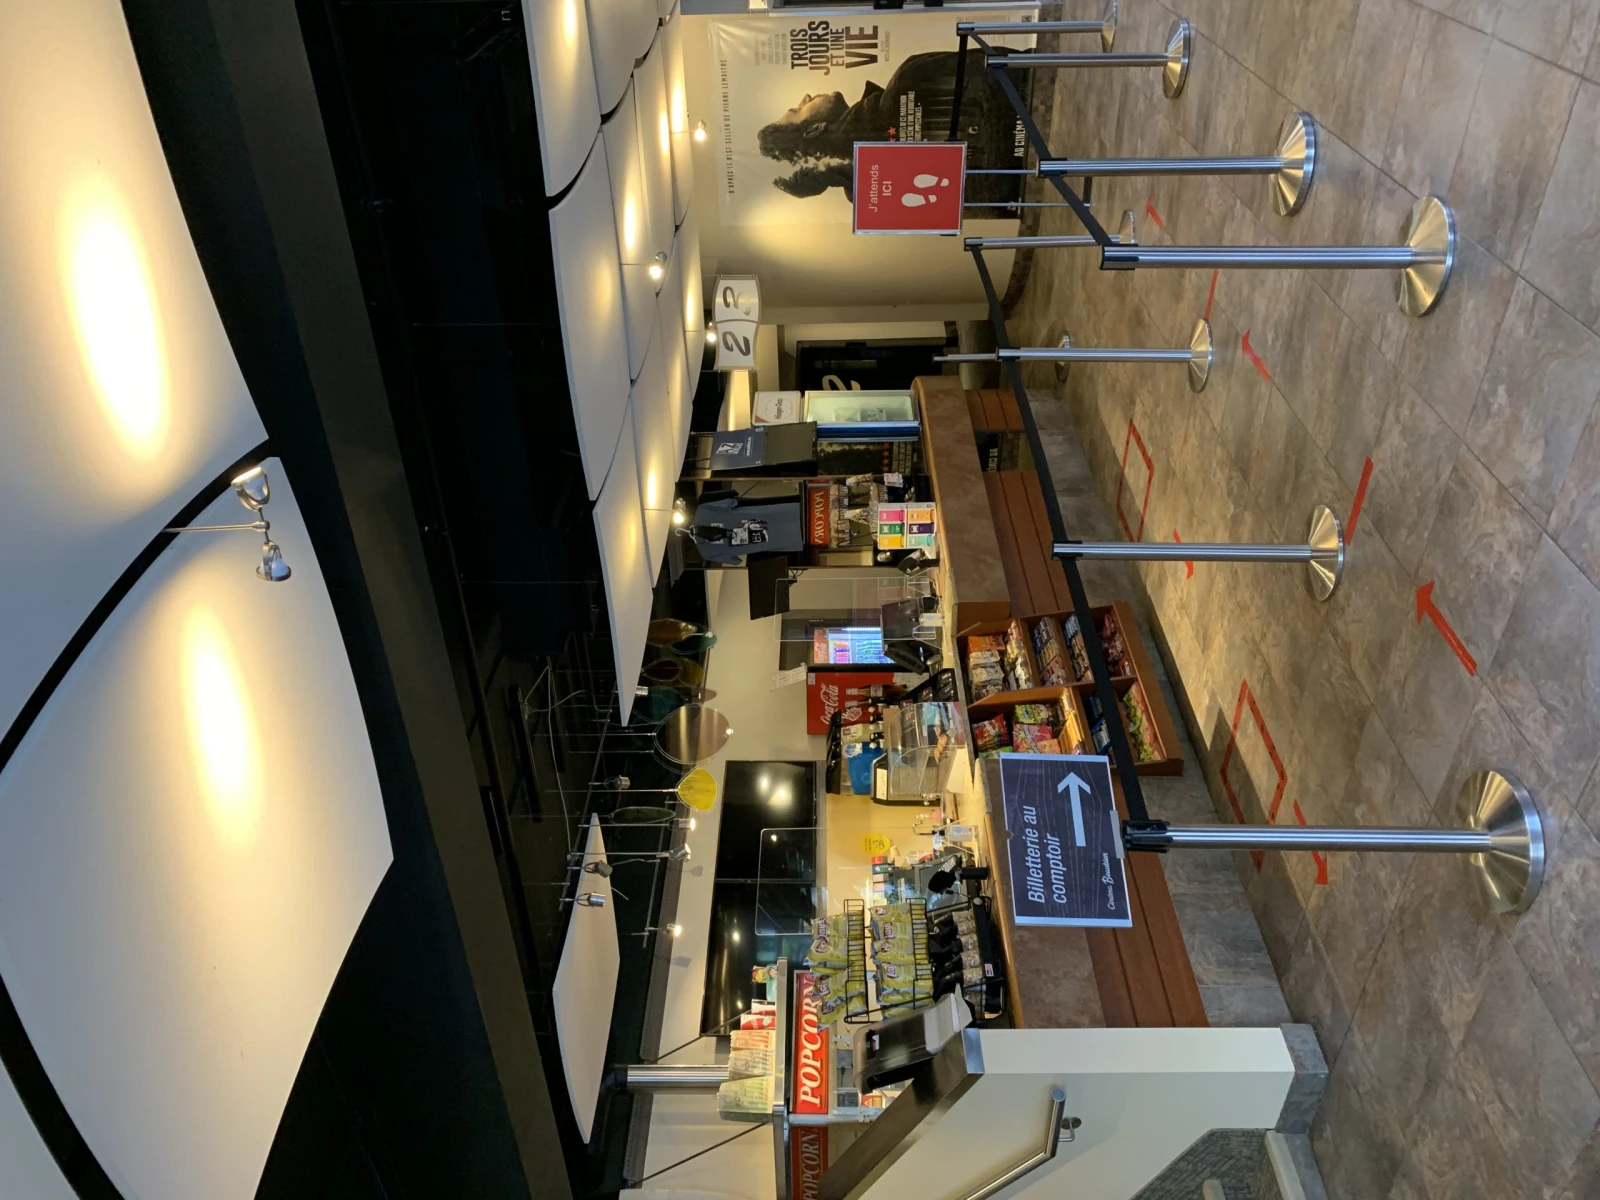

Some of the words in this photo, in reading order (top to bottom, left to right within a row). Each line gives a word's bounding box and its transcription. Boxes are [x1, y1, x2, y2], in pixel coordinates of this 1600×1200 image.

[790, 28, 808, 69] TROIS
[808, 21, 830, 76] JOURS
[830, 28, 844, 50] UNE
[845, 26, 878, 68] VIE
[830, 54, 844, 66] ET
[1014, 148, 1024, 156] AU
[869, 164, 879, 212] J'attends
[883, 180, 892, 196] ICI
[722, 331, 750, 356] 2
[1022, 805, 1037, 824] au
[1023, 828, 1045, 903] Billetterie
[1044, 833, 1067, 904] comptoir
[1107, 885, 1116, 910] Cinéma
[800, 978, 821, 1106] POPCORN
[802, 1131, 820, 1200] POPCORN
